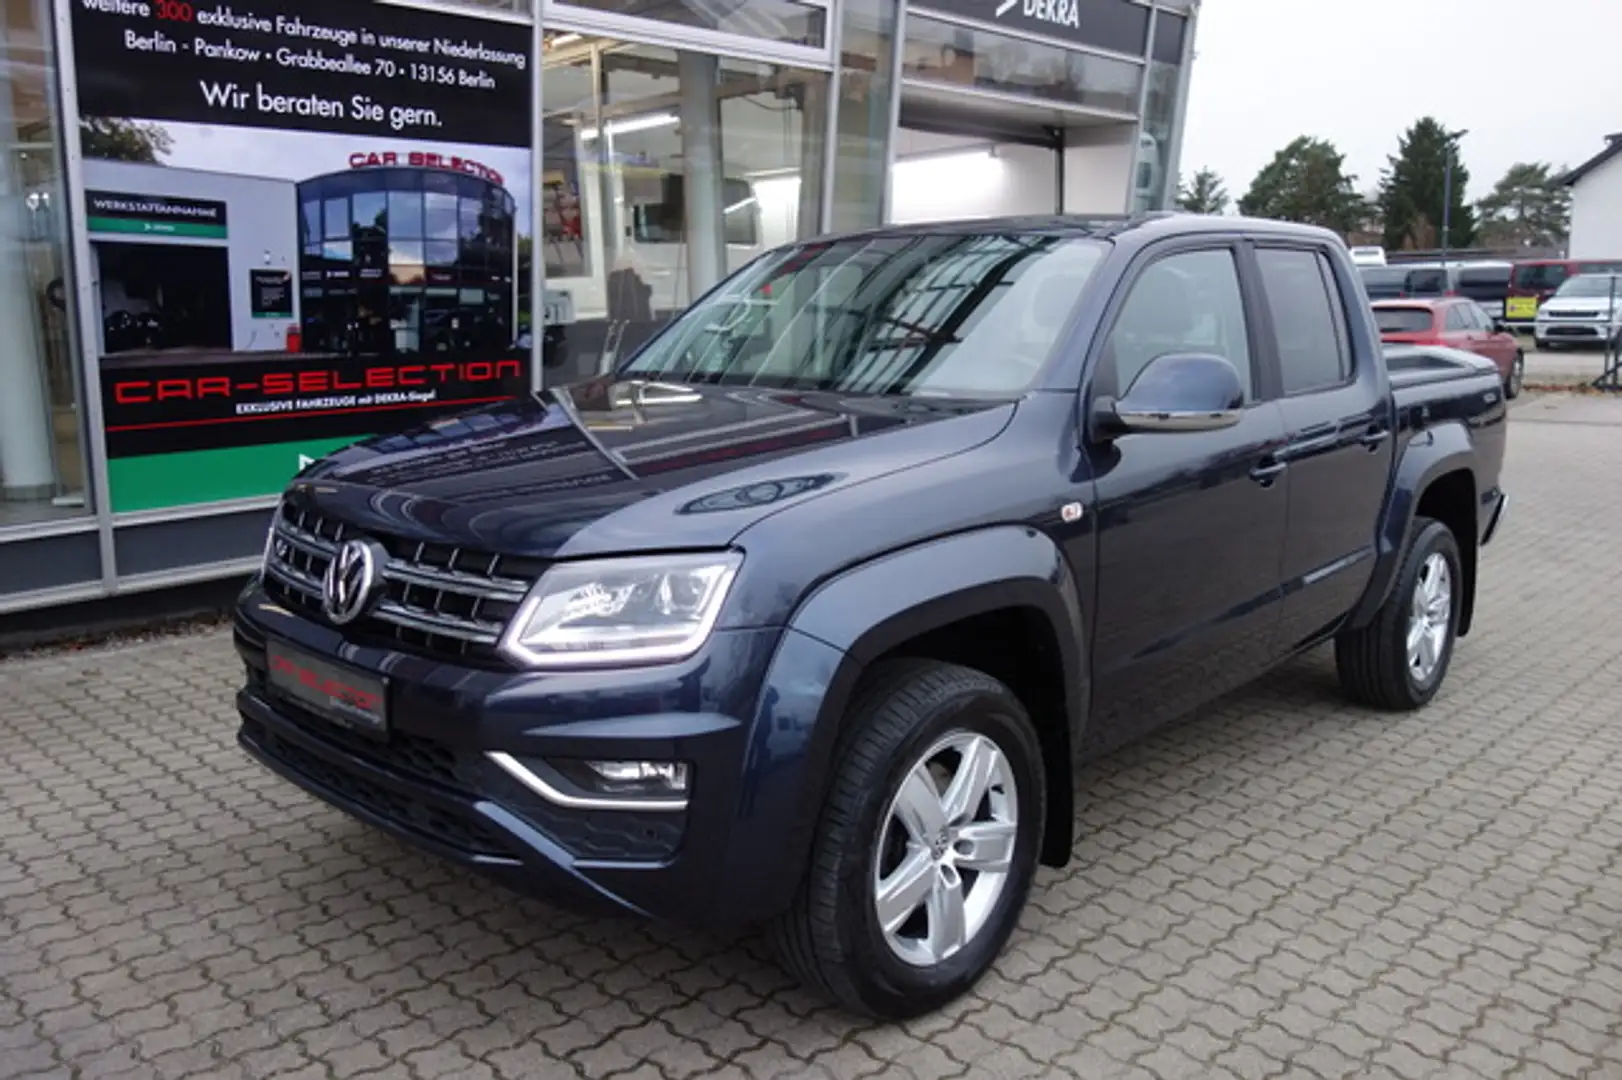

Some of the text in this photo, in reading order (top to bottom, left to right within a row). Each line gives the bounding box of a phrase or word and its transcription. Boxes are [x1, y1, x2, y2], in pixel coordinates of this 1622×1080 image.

[155, 0, 192, 21] 300
[197, 5, 273, 33] exklusive
[276, 15, 358, 47] Fahrzeuge
[361, 28, 376, 44] in
[379, 34, 431, 53] unserer
[433, 37, 527, 70] Niederlassung
[1023, 0, 1079, 28] DEKRA
[124, 29, 177, 53] Berlin
[194, 37, 261, 61] Pankow
[276, 47, 371, 76] Grabbeallee
[375, 59, 396, 78] 70
[410, 63, 456, 85] 13156
[458, 69, 496, 89] Berlin
[199, 79, 443, 130] Wir beraten Sie gern.
[349, 151, 397, 169] CAR
[114, 359, 521, 404] CAR-SELECTION
